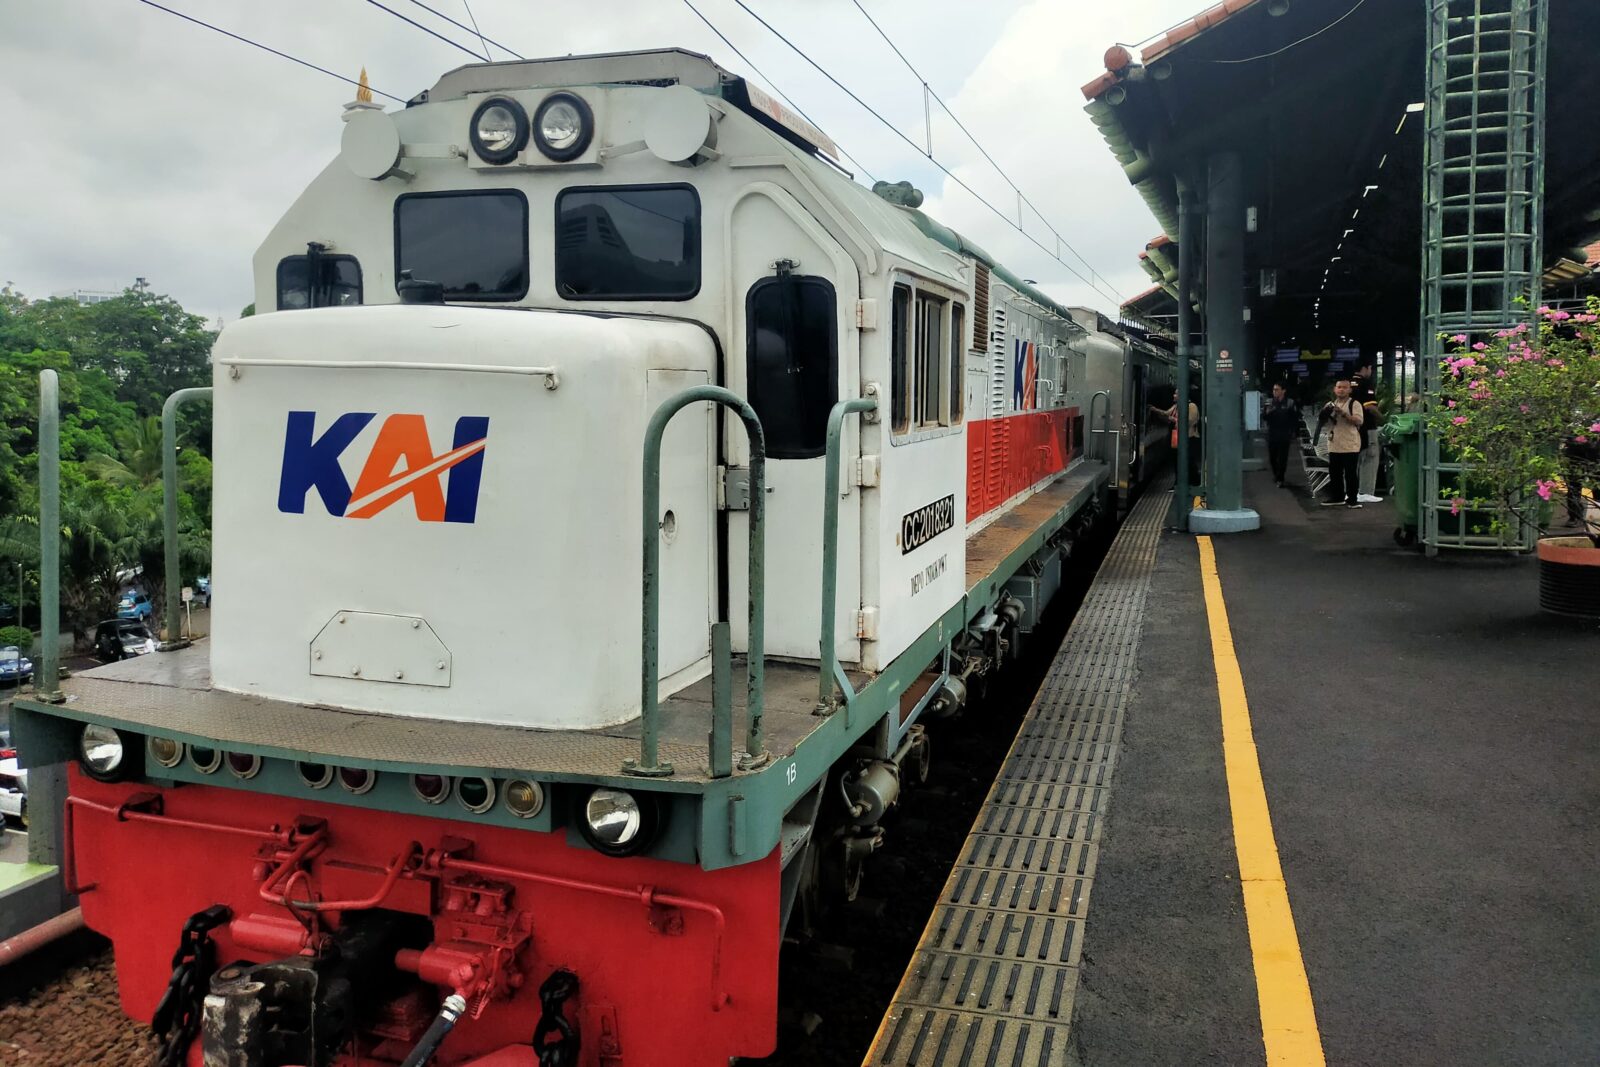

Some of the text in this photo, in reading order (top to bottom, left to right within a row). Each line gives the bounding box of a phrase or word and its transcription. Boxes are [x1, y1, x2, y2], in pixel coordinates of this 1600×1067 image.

[278, 411, 489, 523] KAI
[904, 496, 953, 551] CC2018321
[786, 762, 797, 786] 1B
